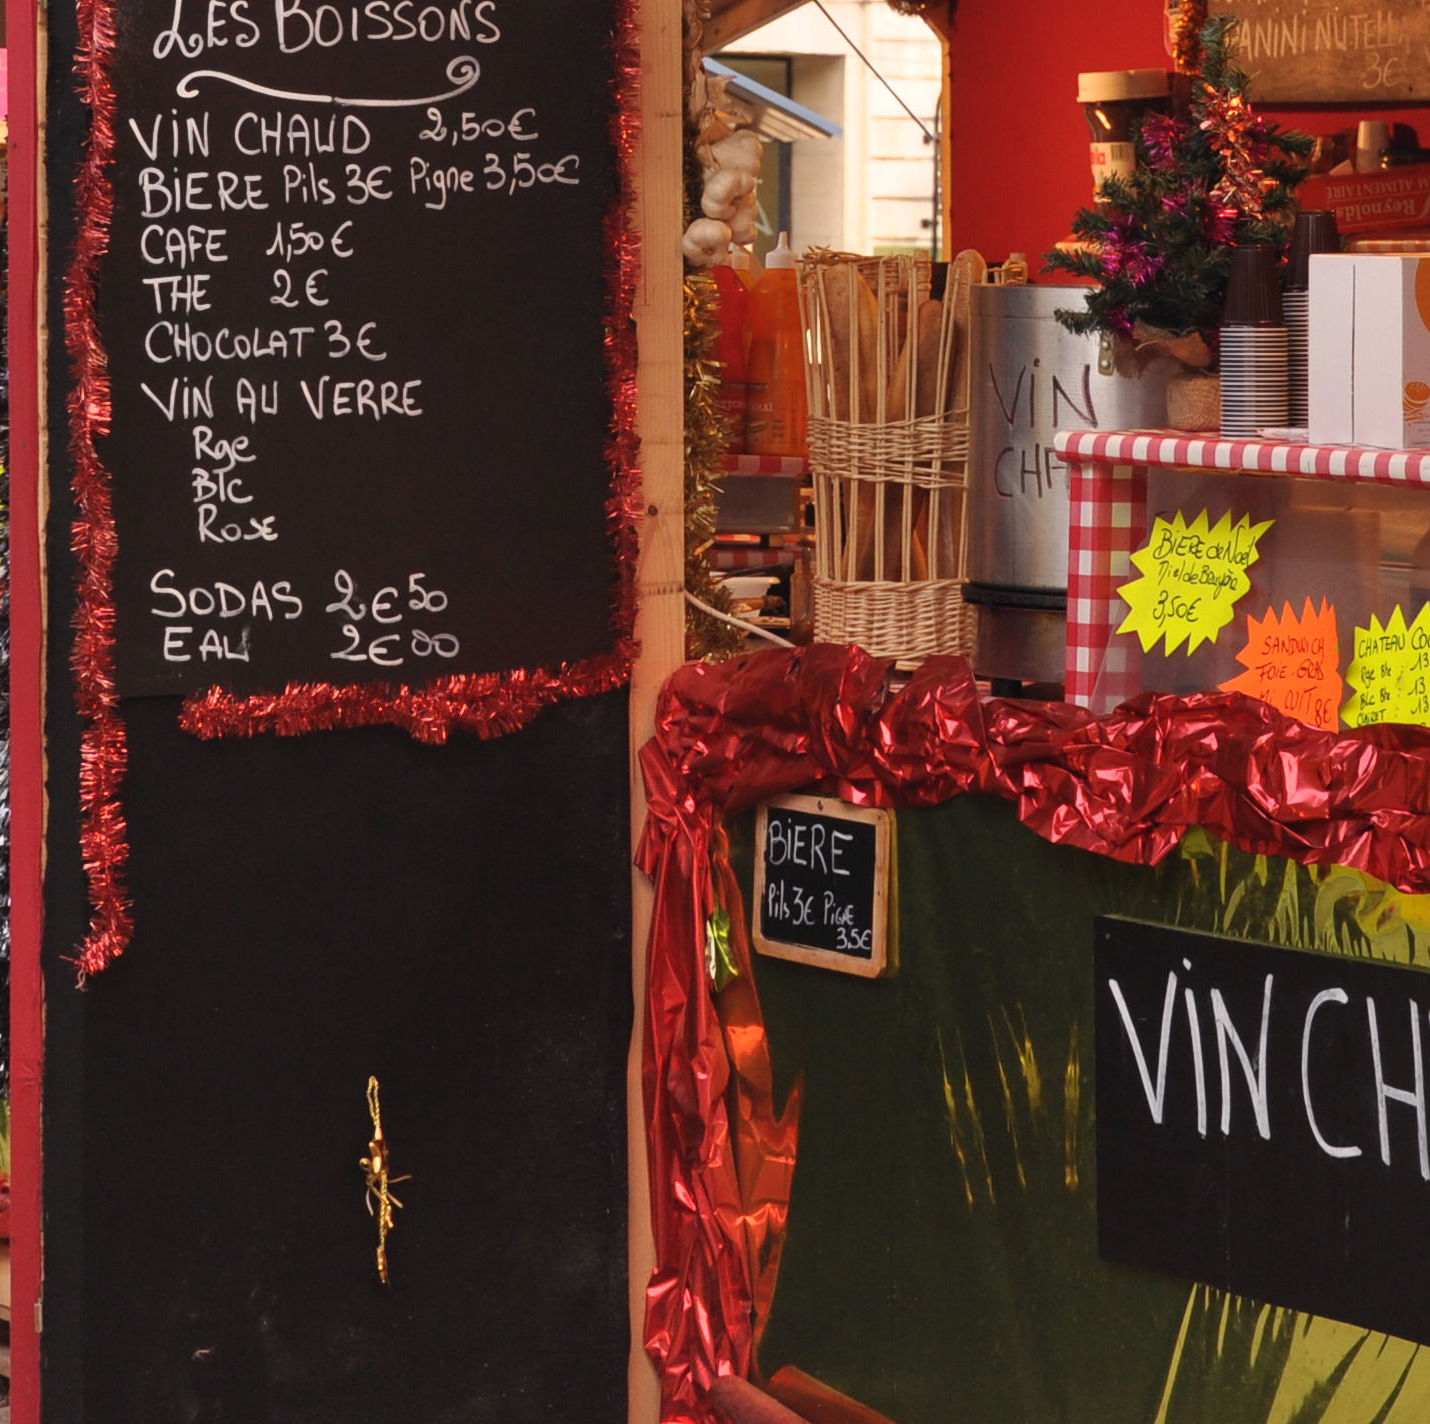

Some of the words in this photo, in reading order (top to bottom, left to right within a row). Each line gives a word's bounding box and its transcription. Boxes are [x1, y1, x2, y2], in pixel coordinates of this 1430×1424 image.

[234, 111, 371, 158] CHAUD
[418, 107, 540, 147] 2,50€
[283, 164, 336, 206] Pils
[345, 164, 393, 205] 3€
[409, 156, 474, 211] Pigne
[483, 152, 580, 196] 3,50€
[1335, 198, 1416, 223] Reynolds
[139, 224, 229, 269] CAFE
[142, 274, 211, 315] THE
[145, 320, 315, 364] CHOCOLAT
[236, 378, 278, 424] AU
[300, 375, 423, 422] VERRE
[193, 425, 257, 474] Rge
[149, 568, 303, 621] SODAS
[1153, 590, 1202, 629] 3,50€
[163, 626, 250, 663] EAU
[1358, 631, 1405, 659] CHATEAU
[768, 879, 791, 921] Pils
[792, 886, 814, 925] 3€
